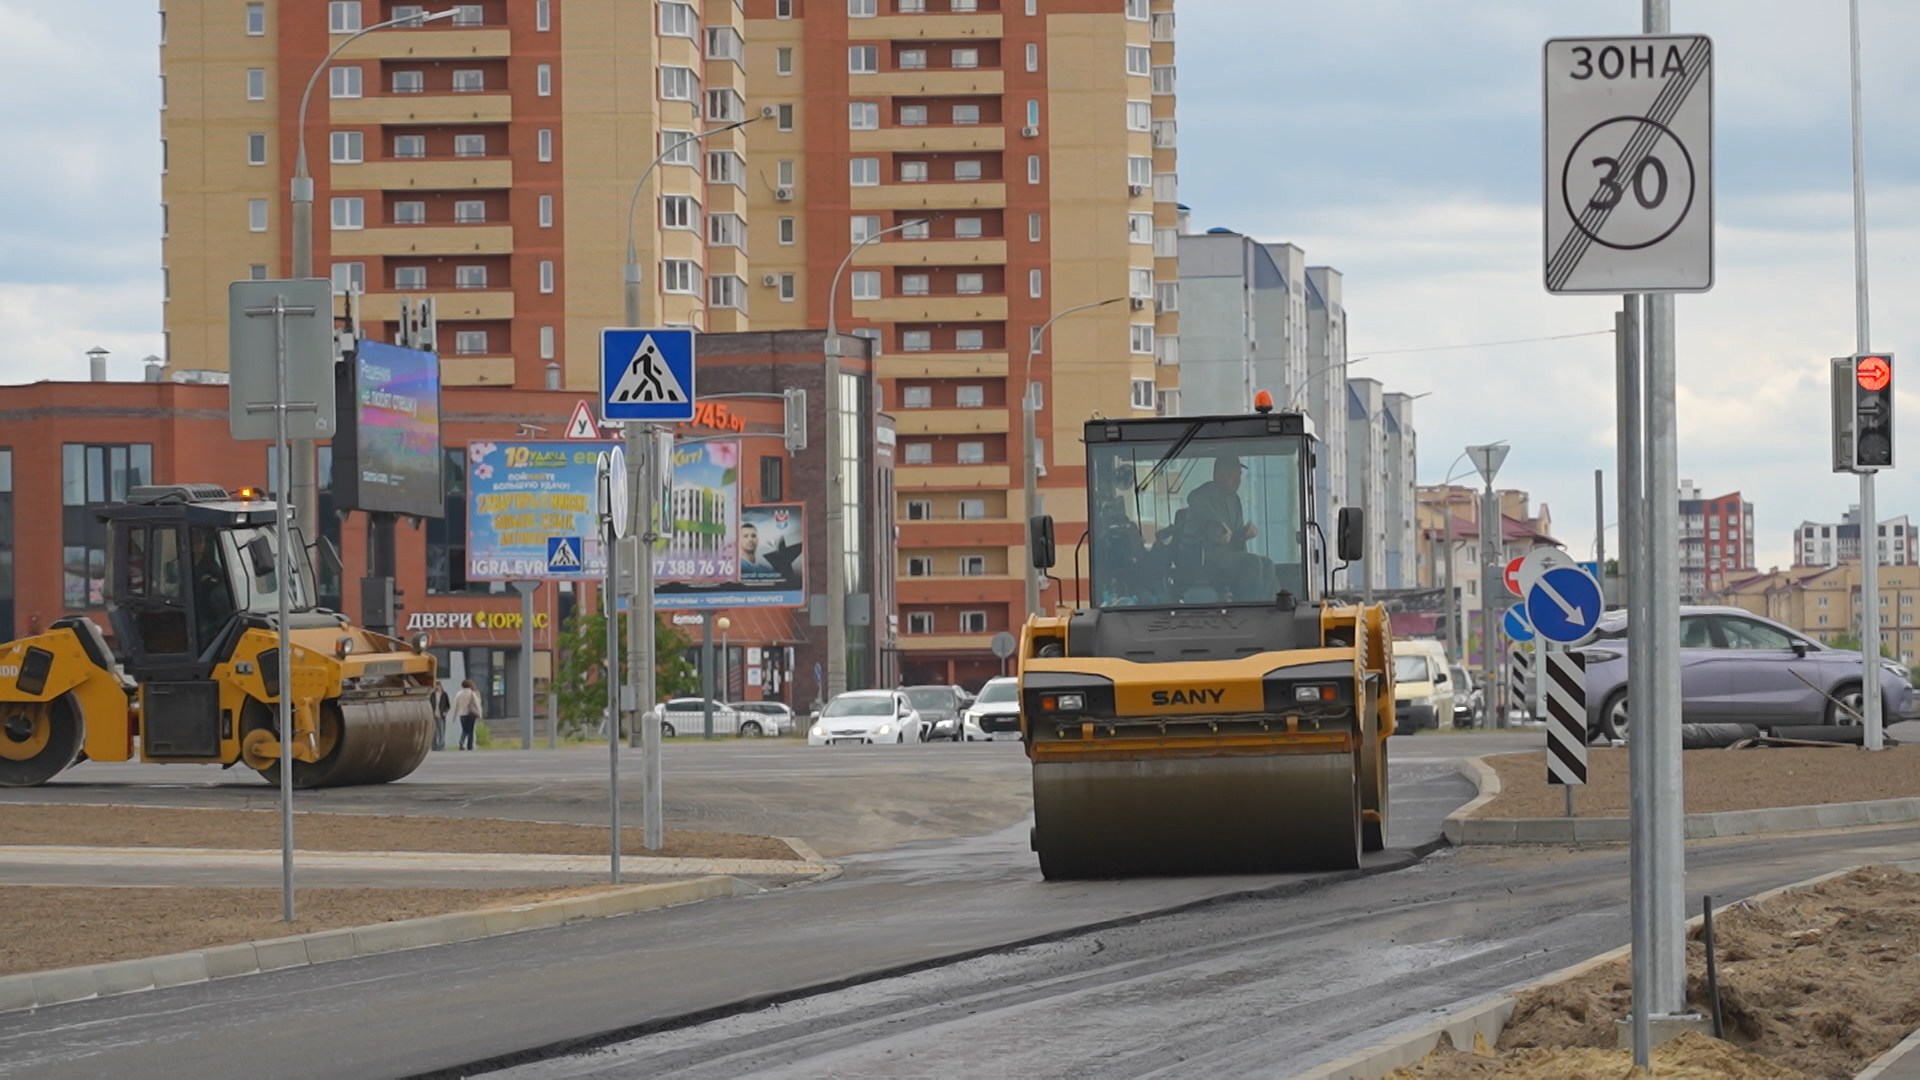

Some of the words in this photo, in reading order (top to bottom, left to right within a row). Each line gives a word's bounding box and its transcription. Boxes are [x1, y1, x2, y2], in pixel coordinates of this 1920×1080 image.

[1570, 45, 1687, 80] ЗОНА
[1590, 155, 1668, 210] 30
[677, 402, 746, 433] 745.by
[668, 560, 695, 575] 388
[698, 560, 714, 575] 76
[718, 560, 734, 575] 76
[406, 613, 473, 629] ДВЕРИ
[672, 613, 704, 625] lamod
[1152, 688, 1225, 706] SANY
